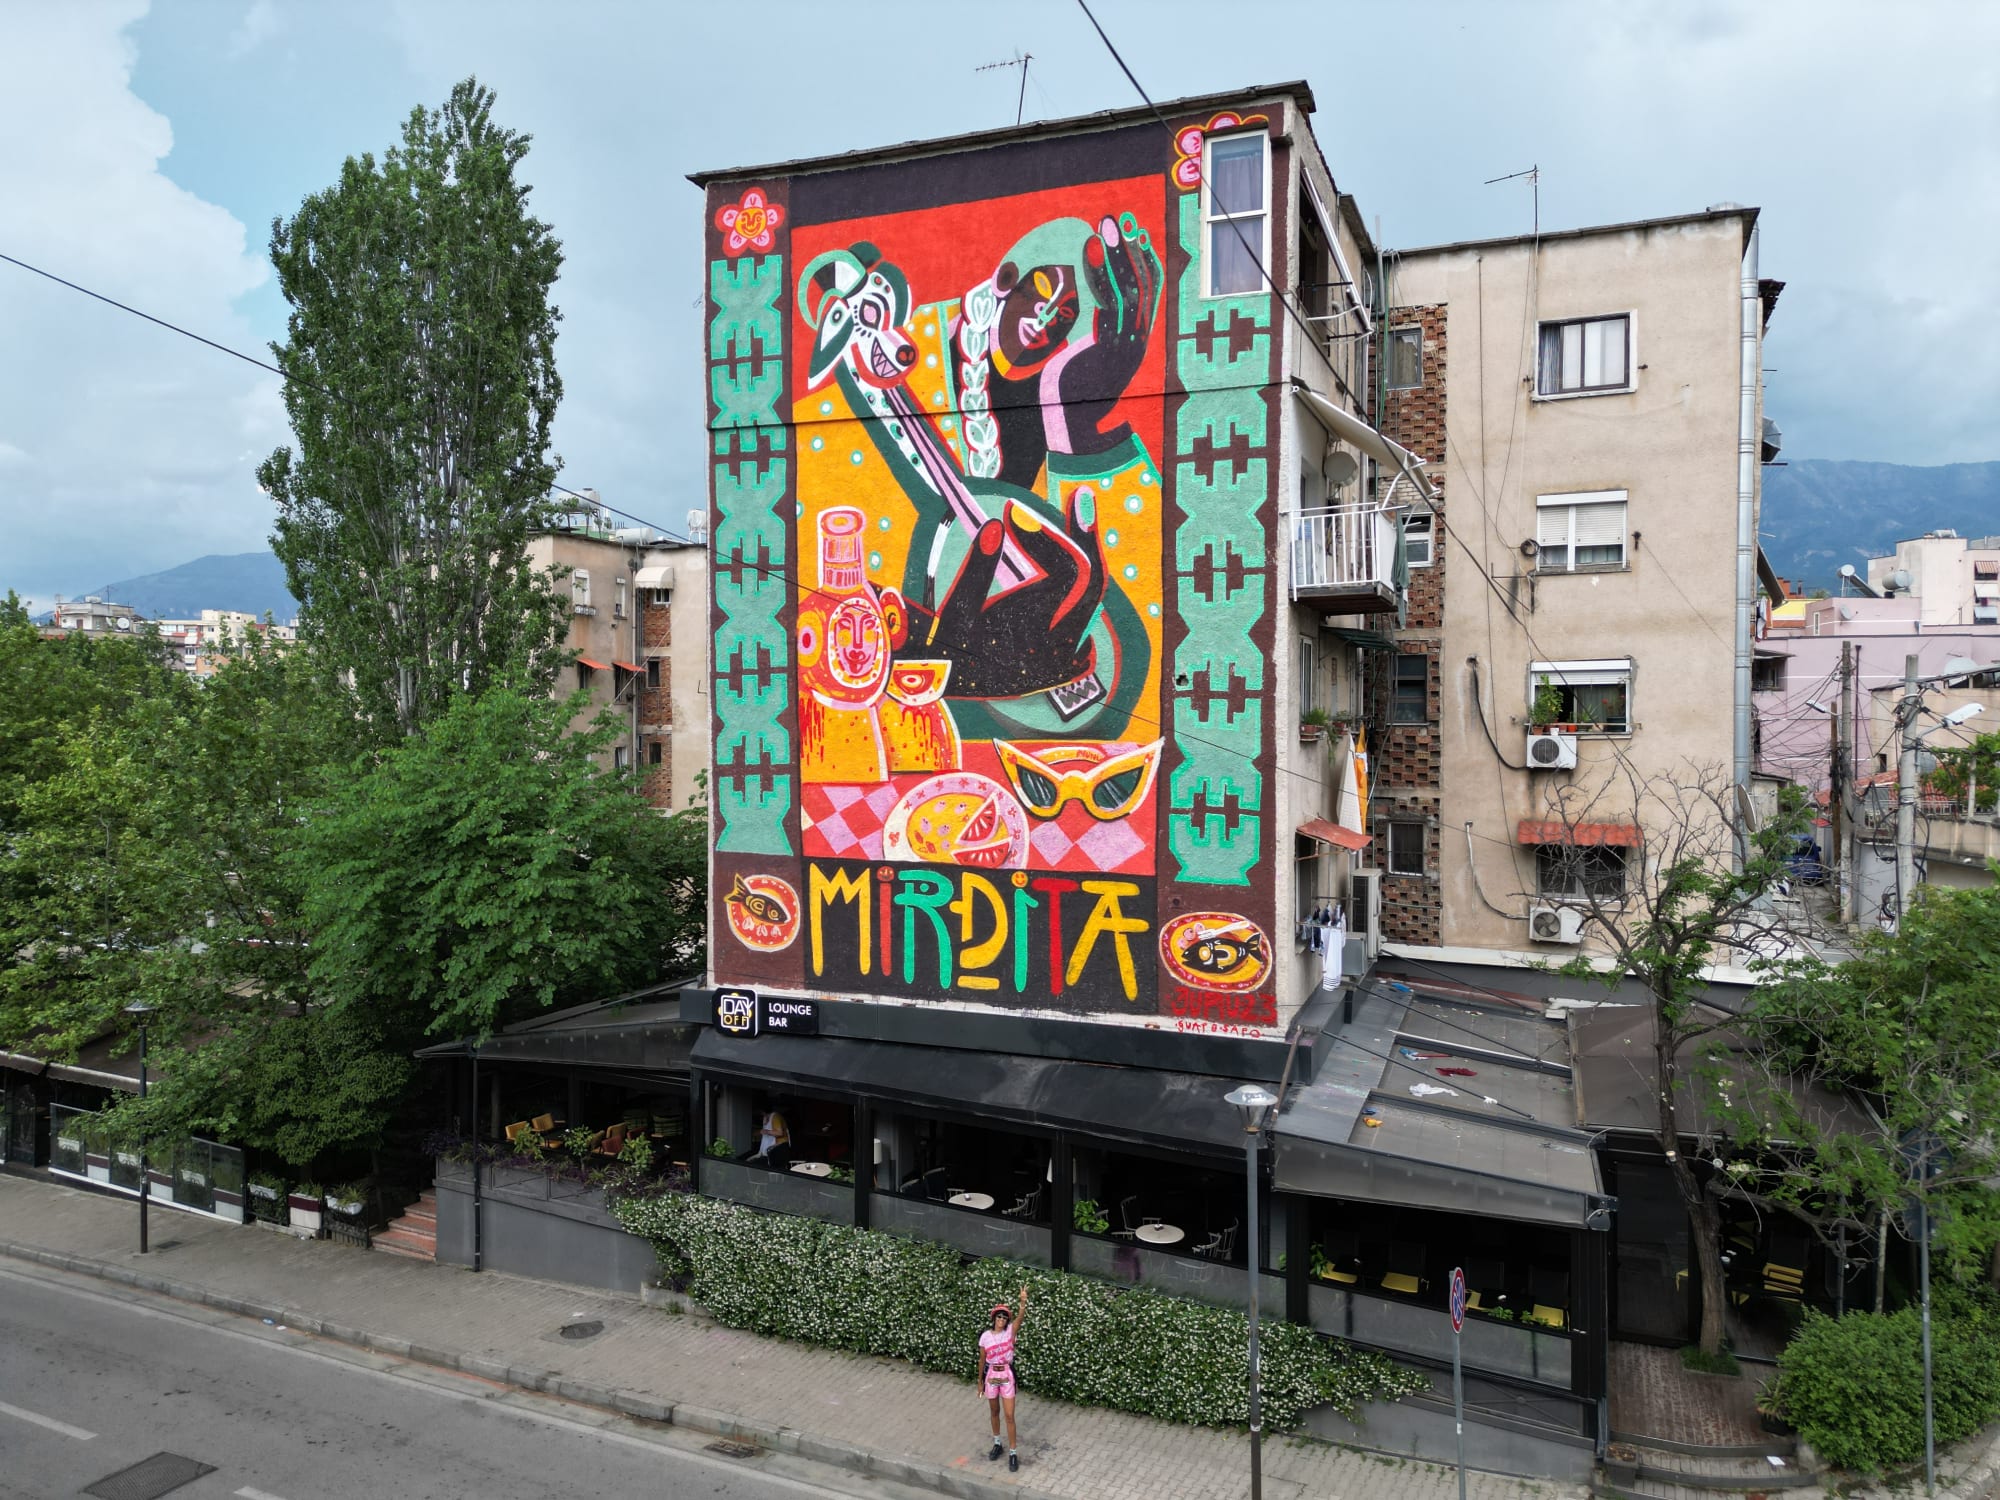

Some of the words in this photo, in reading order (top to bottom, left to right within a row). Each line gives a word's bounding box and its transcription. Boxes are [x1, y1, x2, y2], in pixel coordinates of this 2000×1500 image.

[723, 998, 754, 1015] DAY
[768, 1002, 812, 1016] LOUNGE
[723, 1014, 748, 1027] OFF
[768, 1016, 788, 1028] BAR
